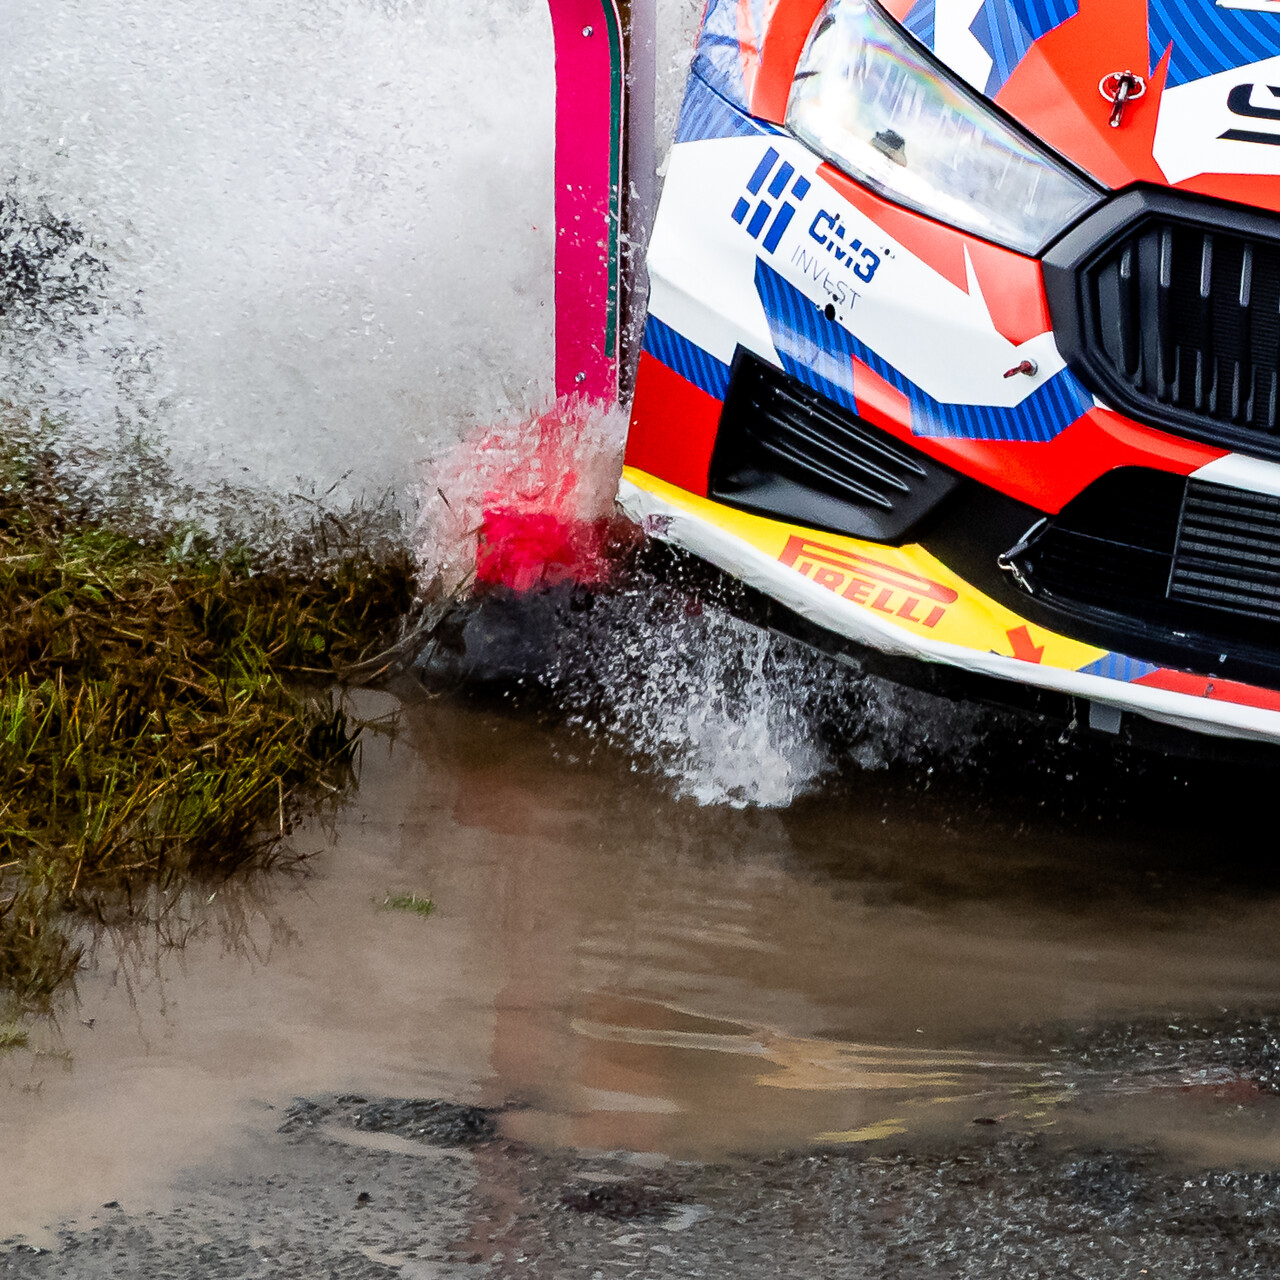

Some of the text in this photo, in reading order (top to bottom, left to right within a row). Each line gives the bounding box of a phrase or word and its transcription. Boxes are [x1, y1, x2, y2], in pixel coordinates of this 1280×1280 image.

[790, 244, 862, 311] INVEST
[808, 208, 881, 284] CM3
[777, 534, 960, 629] PIRELLI
